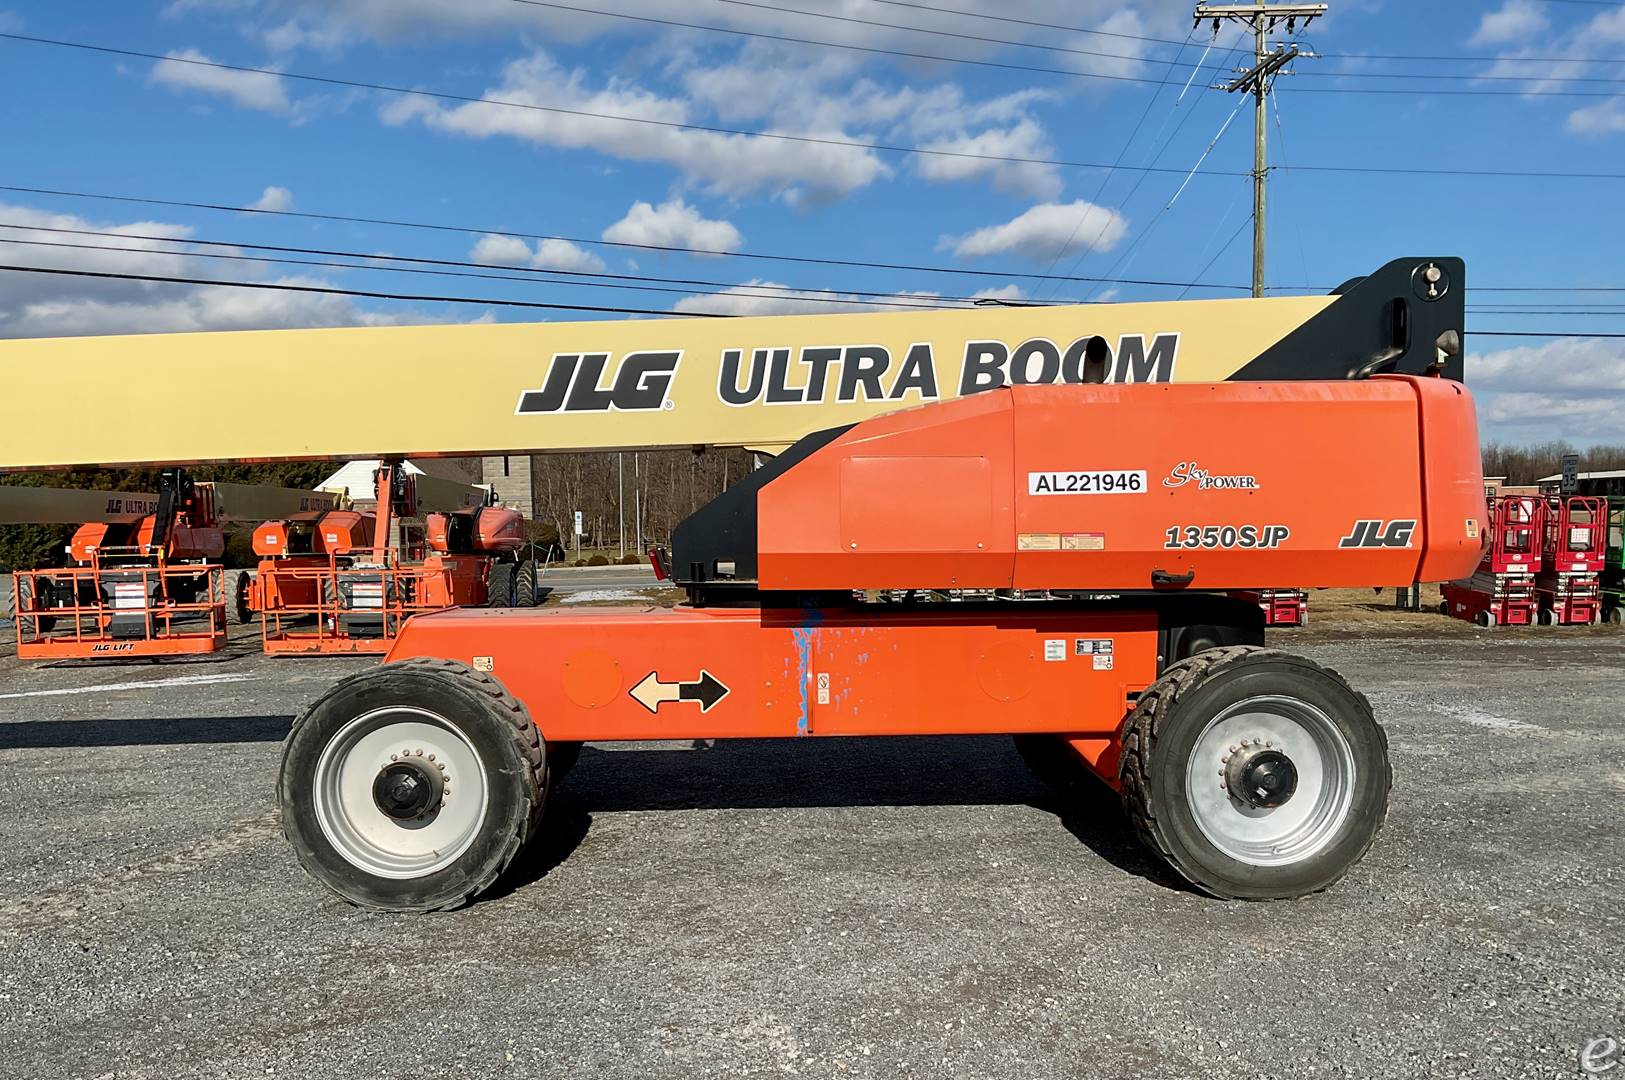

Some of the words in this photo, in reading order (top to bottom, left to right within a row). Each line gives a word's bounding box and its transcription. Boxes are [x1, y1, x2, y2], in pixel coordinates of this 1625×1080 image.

[515, 349, 685, 414] JLG
[718, 342, 939, 407] ULTRA
[957, 332, 1181, 397] BOOM
[1035, 473, 1142, 493] AL221946
[1563, 474, 1576, 487] 35
[105, 499, 122, 514] JLG
[126, 500, 147, 514] ULTRA
[1164, 525, 1289, 550] 1350SJP
[1338, 519, 1417, 549] JLG
[92, 644, 111, 652] JLG
[113, 643, 135, 651] LIFT
